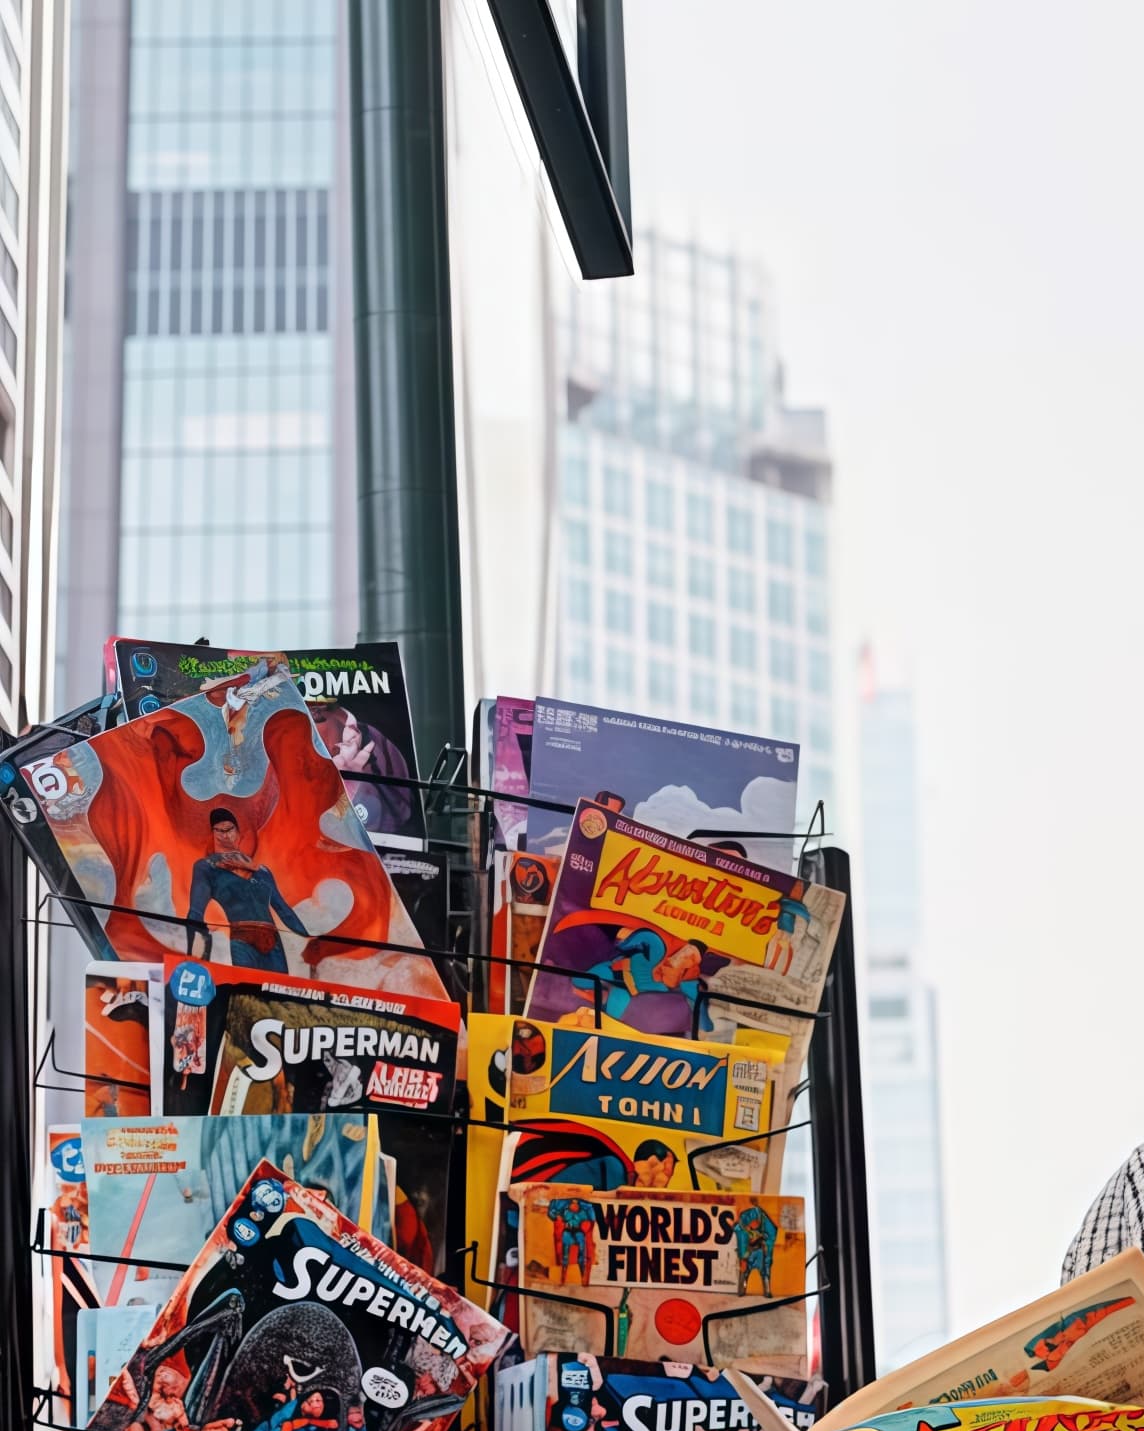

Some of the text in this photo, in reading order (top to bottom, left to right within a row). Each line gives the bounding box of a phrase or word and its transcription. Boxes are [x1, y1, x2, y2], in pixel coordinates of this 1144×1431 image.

[298, 670, 391, 697] OMAN
[246, 1018, 440, 1082] SUPERMAN
[594, 1203, 735, 1245] WORLD'S
[607, 1245, 719, 1286] FINEST
[272, 1246, 468, 1360] SUPERMEN
